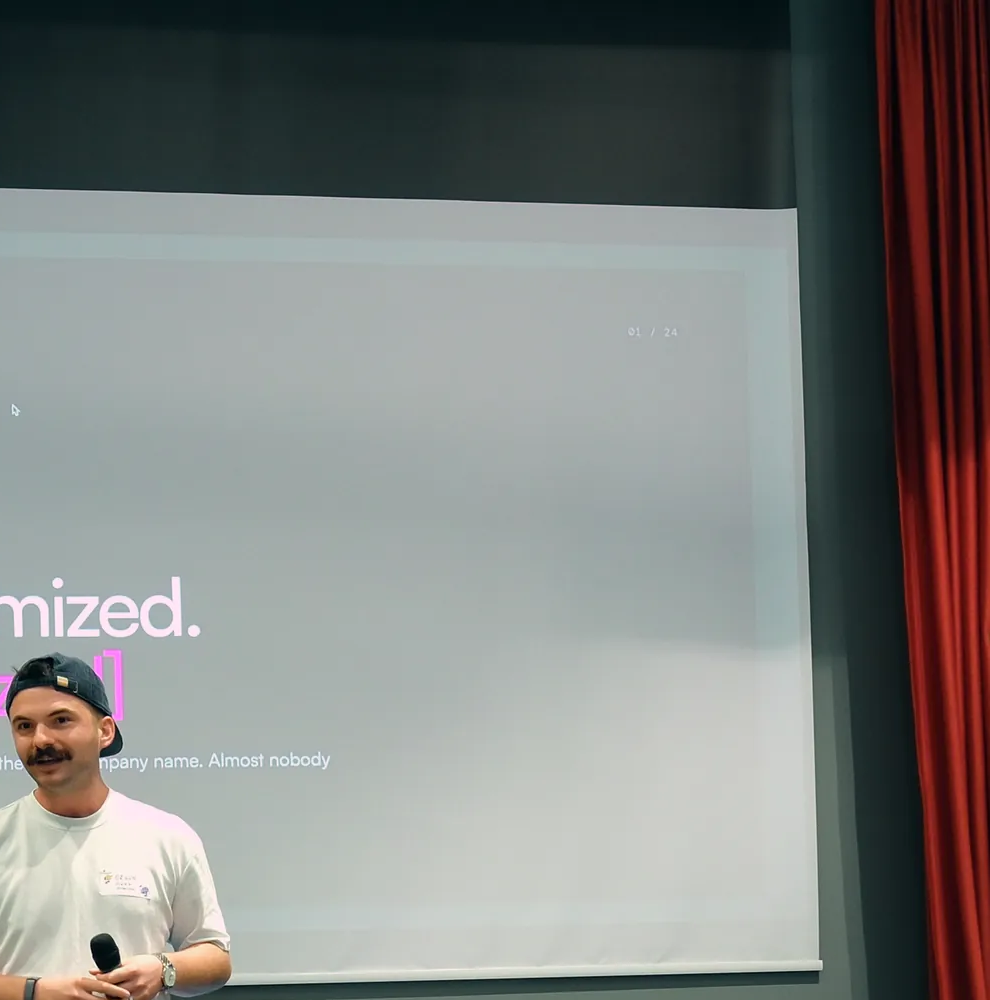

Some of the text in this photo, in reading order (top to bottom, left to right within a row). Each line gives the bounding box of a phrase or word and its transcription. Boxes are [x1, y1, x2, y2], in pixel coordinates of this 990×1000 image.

[627, 326, 641, 337] 01
[663, 326, 678, 337] 24
[153, 756, 204, 769] name.
[208, 752, 265, 768] Almost
[269, 751, 331, 770] nobody
